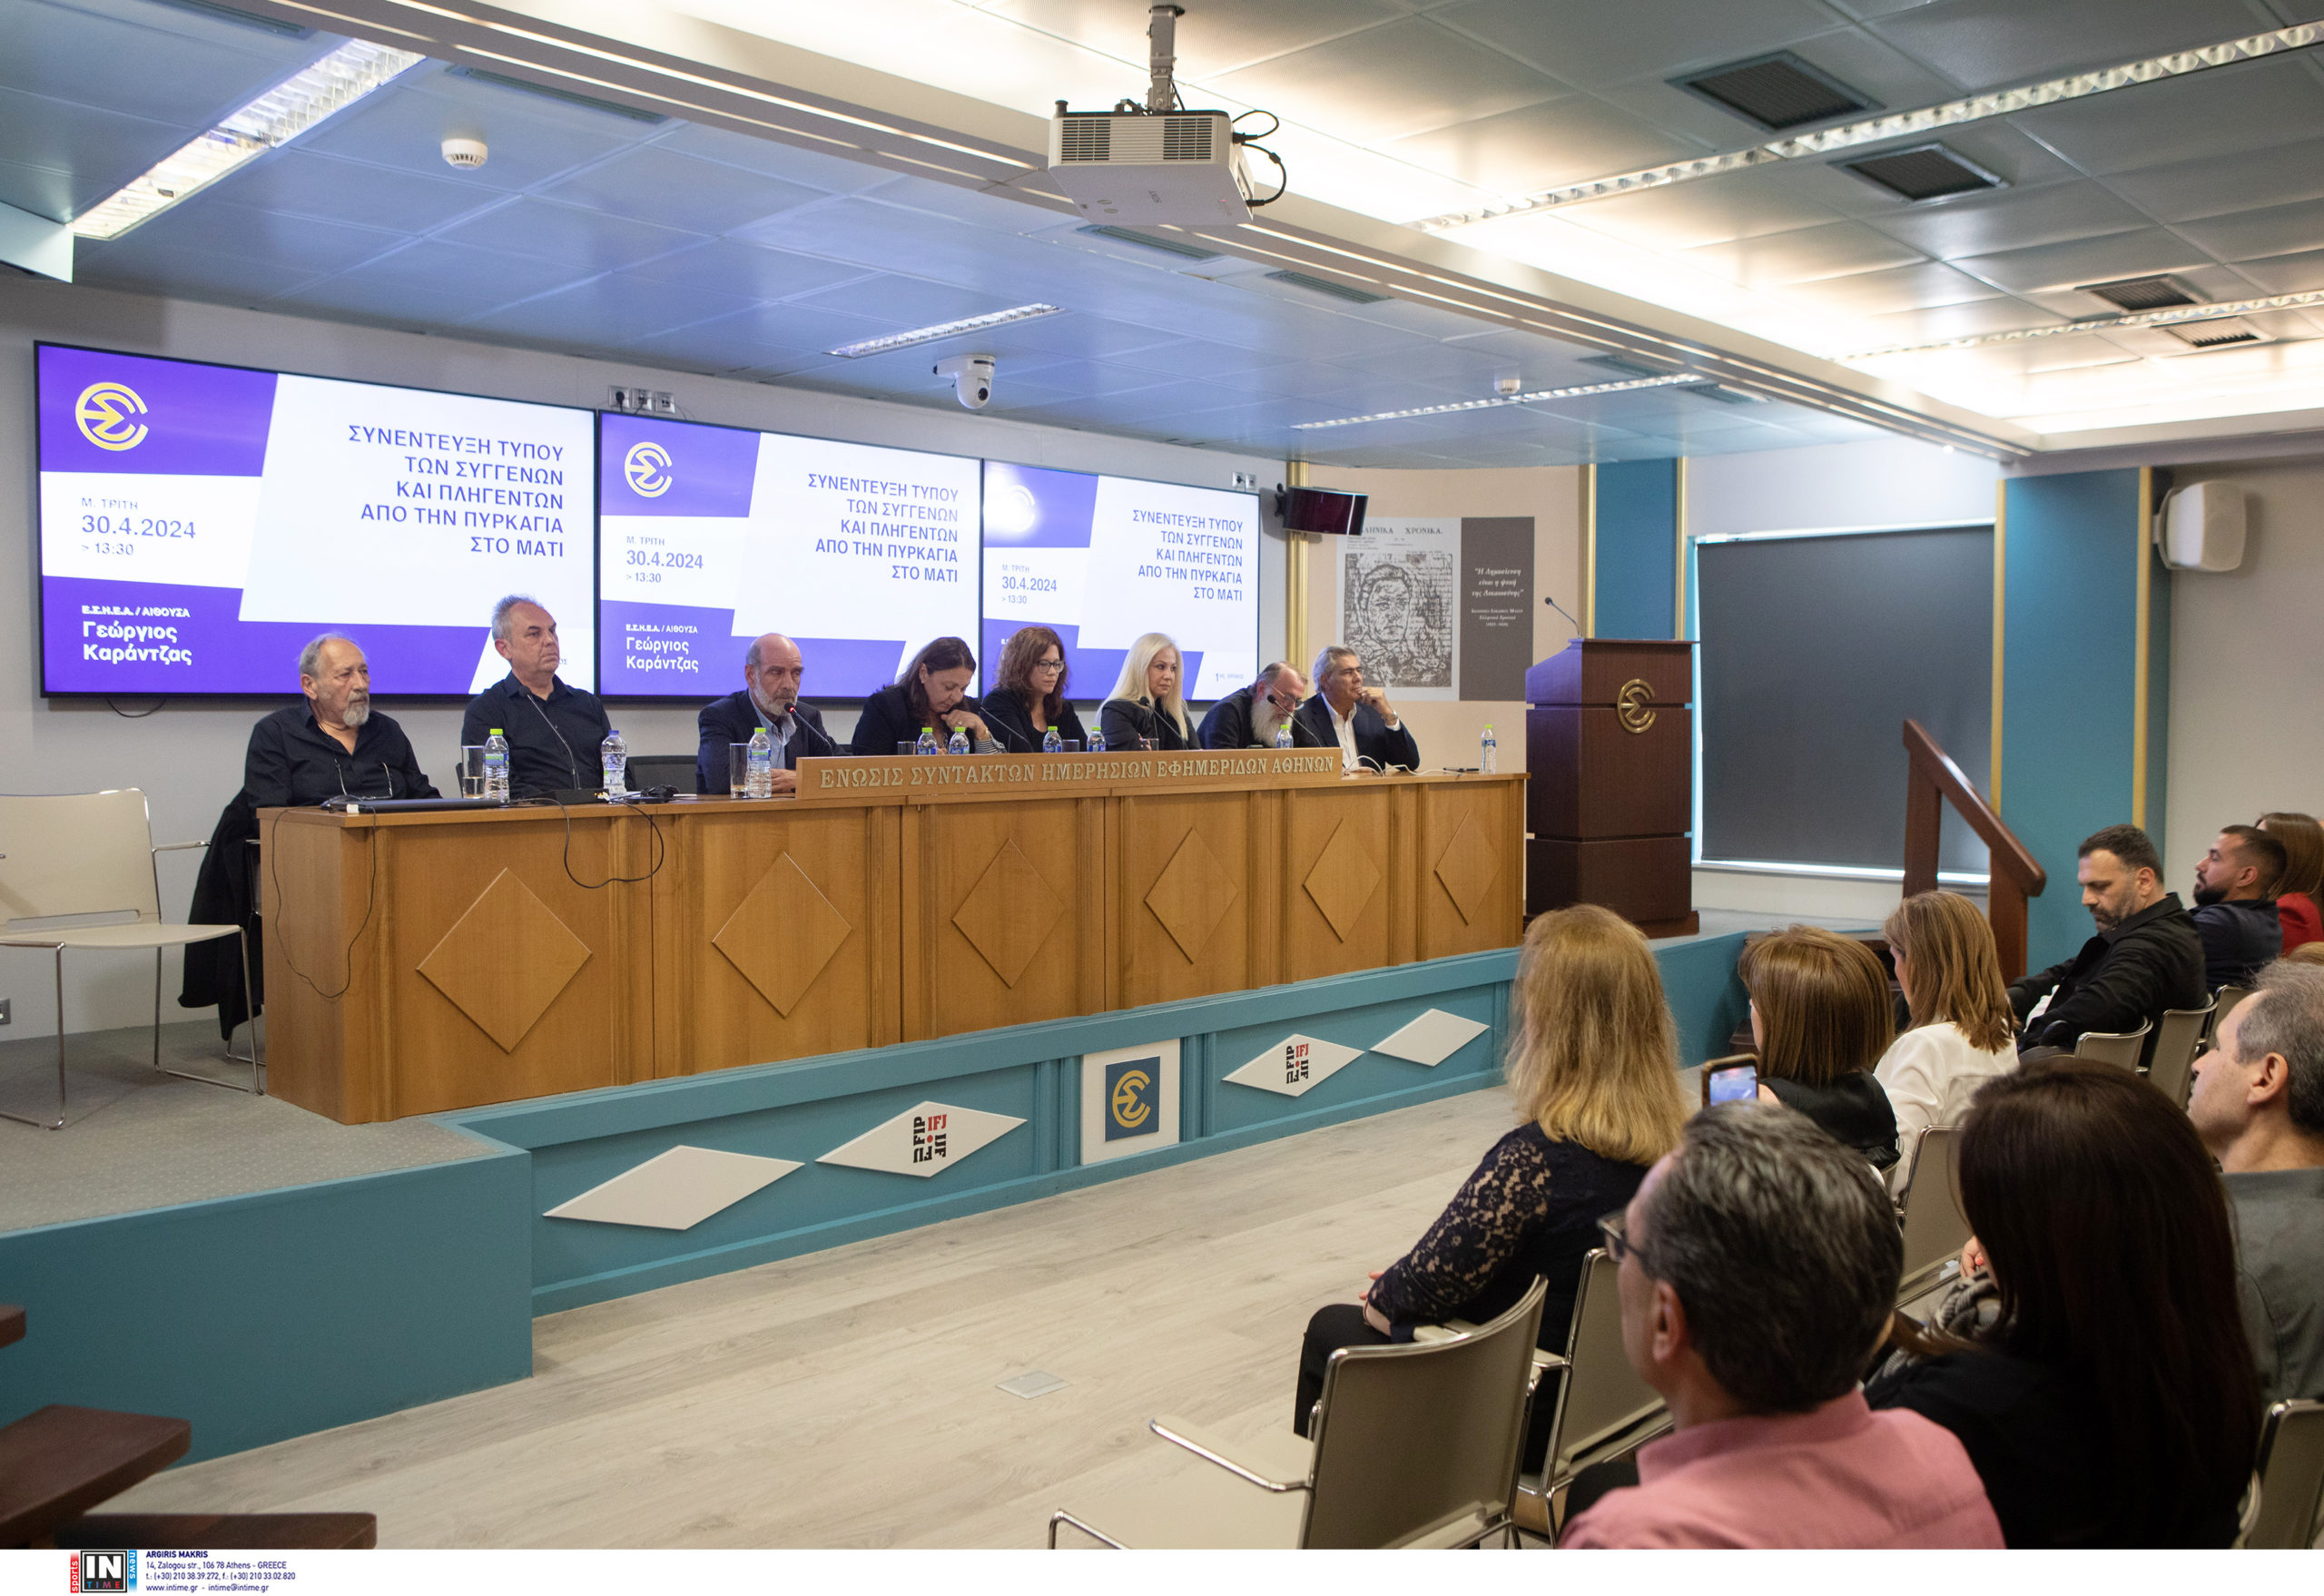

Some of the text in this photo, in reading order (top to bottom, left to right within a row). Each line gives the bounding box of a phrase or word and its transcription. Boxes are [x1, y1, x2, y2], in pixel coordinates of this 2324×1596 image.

[349, 425, 563, 461] ΣΥΝΕΝΤΕΥΞΗ ΤΥΠΟΥ
[404, 456, 563, 486] ΤΩΝ ΣΥΓΓΕΝΩΝ
[397, 480, 563, 509] ΚΑΙ ΠΛΗΓΕΝΤΩΝ
[808, 473, 958, 502] ΣΥΝΕΝΤΕΥΞΗ ΤΥΠΟΥ
[102, 498, 138, 510] ΤΡΙΤΗ
[847, 498, 958, 522] ΤΩΝ ΣΥΓΓΕΝΩΝ
[82, 515, 196, 538] 30.4.2024
[360, 504, 563, 534] ΑΠΟ ΤΗΝ ΠΥΡΚΑΓΙΑ
[1133, 509, 1243, 533] ΣΥΝΕΝΤΕΥΞΗ ΤΥΠΟΥ
[841, 518, 958, 542] ΚΑΙ ΠΛΗΓΕΝΤΩΝ
[1161, 530, 1243, 549] ΤΩΝ ΣΥΓΓΕΝΩΝ
[95, 542, 133, 556] 13:30
[470, 537, 563, 557] ΣΤΟ ΜΑΤΙ
[640, 537, 665, 546] ΤΡΙΤΗ
[815, 538, 958, 563] ΑΠΟ ΤΗΝ ΠΥΡΚΑΓΙΑ
[626, 549, 704, 569] 30.4.2024
[1157, 548, 1242, 566] ΚΑΙ ΠΛΗΓΕΝΤΩΝ
[635, 572, 662, 583] 13:30
[891, 565, 958, 583] ΣΤΟ ΜΑΤΙ
[1138, 565, 1243, 584] ΑΠΟ ΤΗΝ ΠΥΡΚΑΓΙΑ
[1002, 576, 1057, 592] 30.4.2024
[1194, 586, 1242, 601] ΣΤΟ ΜΑΤΙ
[142, 606, 191, 618] ΑΙΘΟΥΣΑ
[83, 620, 178, 644] Γεώργιος
[665, 625, 698, 634] ΑΙΘΟΥΣΑ
[83, 643, 192, 666] Καράντζας
[626, 636, 689, 655] Γεώργιος
[626, 655, 699, 673] Καράντζας
[820, 756, 1334, 789] ΕΝΩΣΙΣ ΣΥΝΤΑΚΤΩΝ ΗΜΕΡΗΣΙΩΝ ΕΦΗΜΕΡΙΔΩΝ ΑΘΗΝΩΝ
[928, 1114, 947, 1131] IFJ
